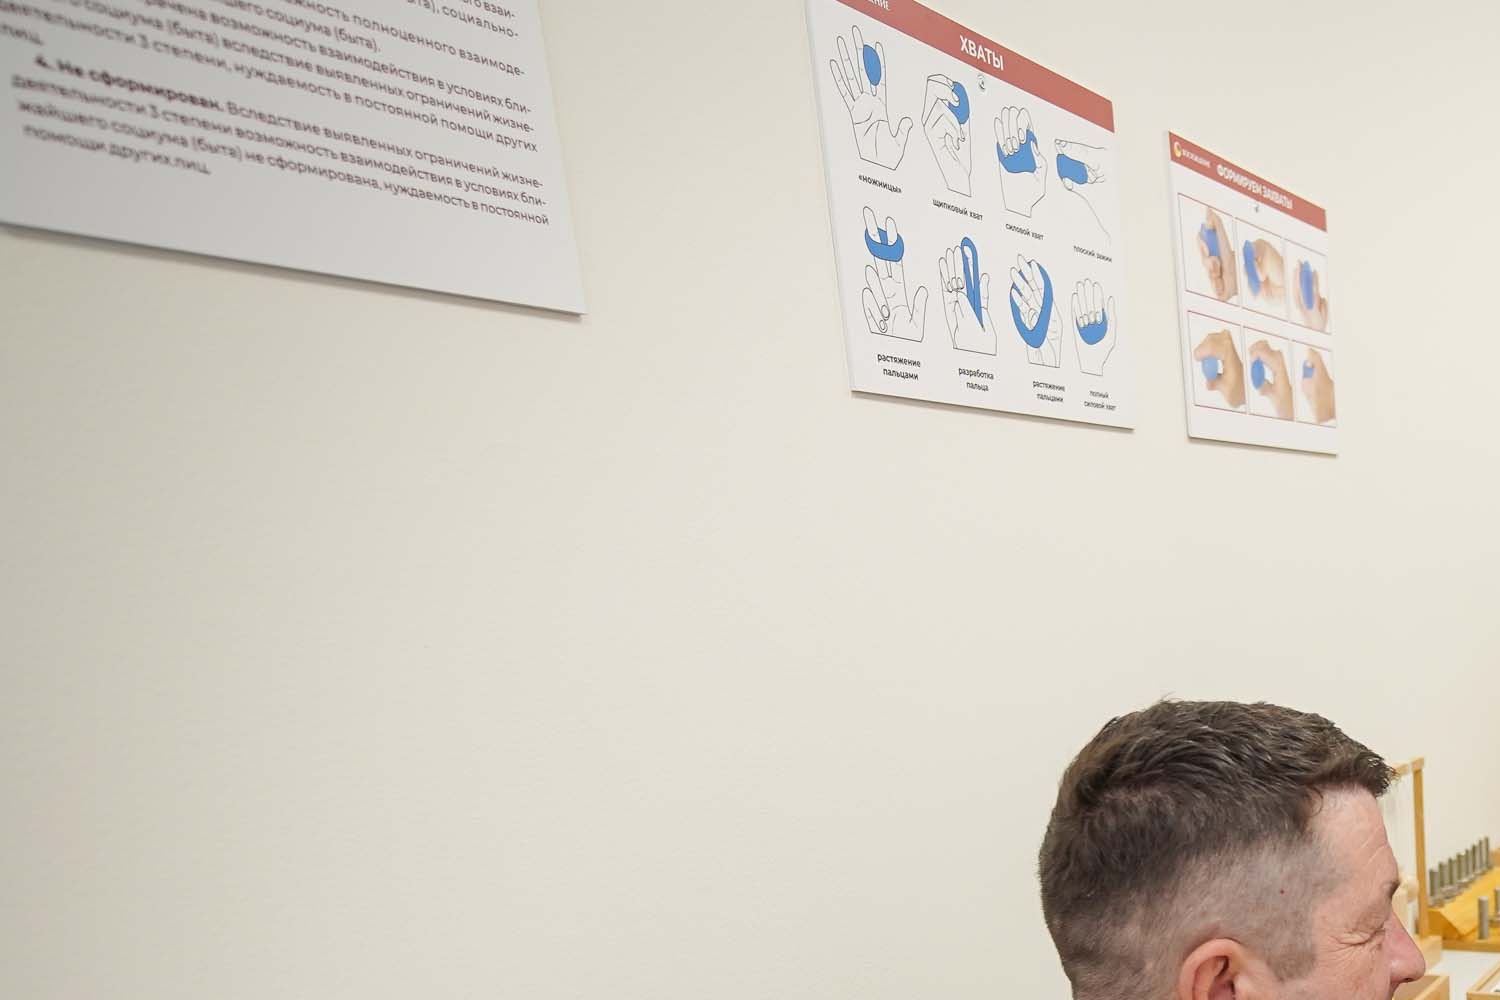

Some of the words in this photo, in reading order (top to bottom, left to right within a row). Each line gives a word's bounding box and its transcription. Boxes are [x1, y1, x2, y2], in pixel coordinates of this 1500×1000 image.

[959, 35, 1004, 71] ХВАТЫ
[877, 353, 921, 368] растяжение
[883, 368, 919, 380] пальцами
[958, 367, 994, 380] разработка
[966, 381, 989, 392] пальца
